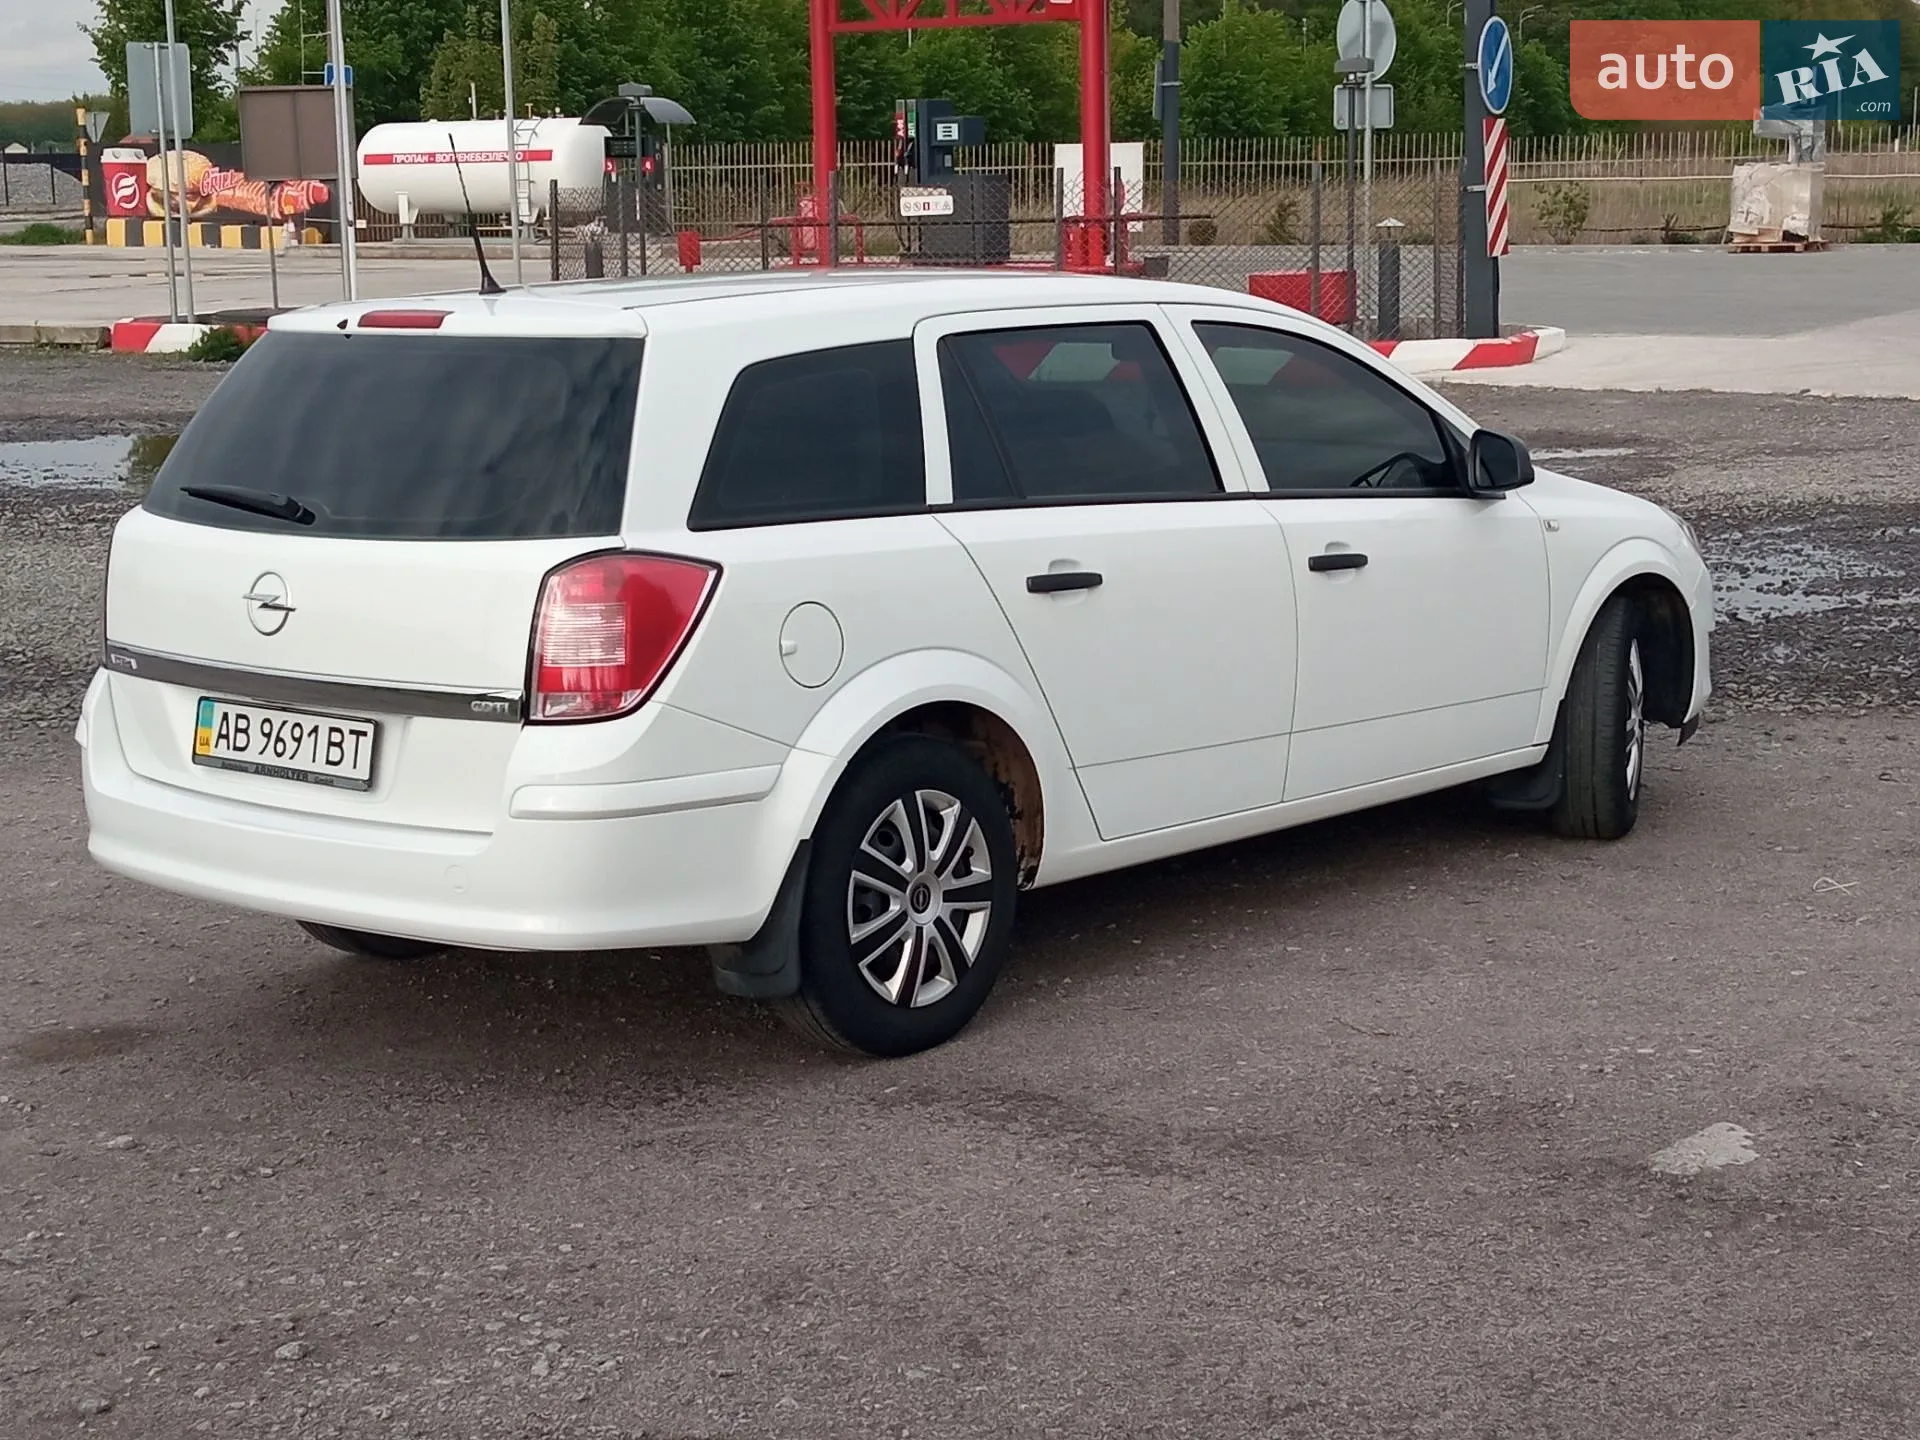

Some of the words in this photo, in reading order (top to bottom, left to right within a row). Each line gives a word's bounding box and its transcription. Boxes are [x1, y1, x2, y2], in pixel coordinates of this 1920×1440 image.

[435, 151, 523, 163] ВОГЕНЕБЕЗПЕЧО
[215, 711, 251, 751] AB
[258, 717, 319, 763] 9691
[325, 726, 368, 769] BT
